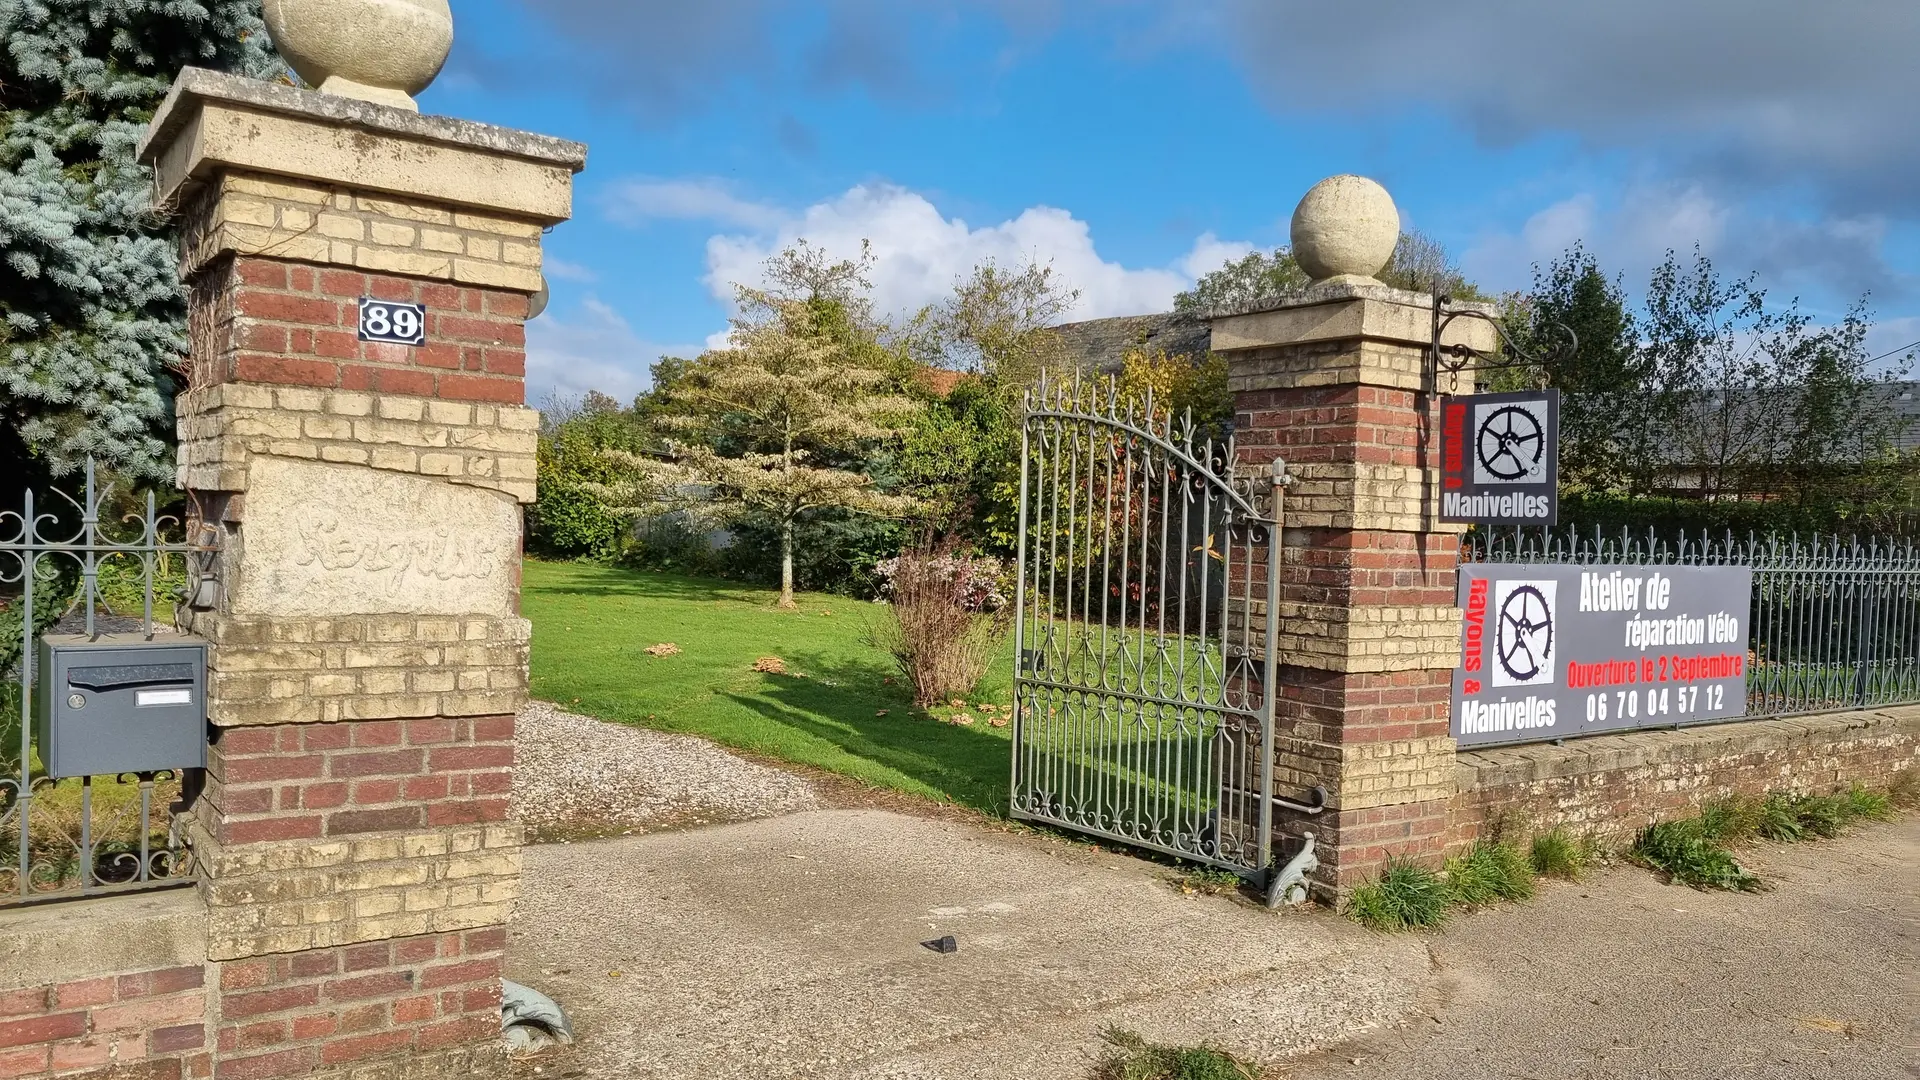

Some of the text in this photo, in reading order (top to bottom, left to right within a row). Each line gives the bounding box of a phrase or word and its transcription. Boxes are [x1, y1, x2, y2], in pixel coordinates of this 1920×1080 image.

[366, 306, 418, 338] 89
[1444, 404, 1466, 473] Rayons
[1443, 491, 1549, 518] Manivelles
[1579, 571, 1670, 612] Atelier de
[1463, 578, 1489, 696] Rayons &
[1625, 610, 1738, 651] réparation Vélo
[1567, 653, 1742, 688] Ouverture le 2 Septembre
[1460, 696, 1556, 735] Manivelles
[1586, 684, 1723, 721] 06 70 04 57 12
